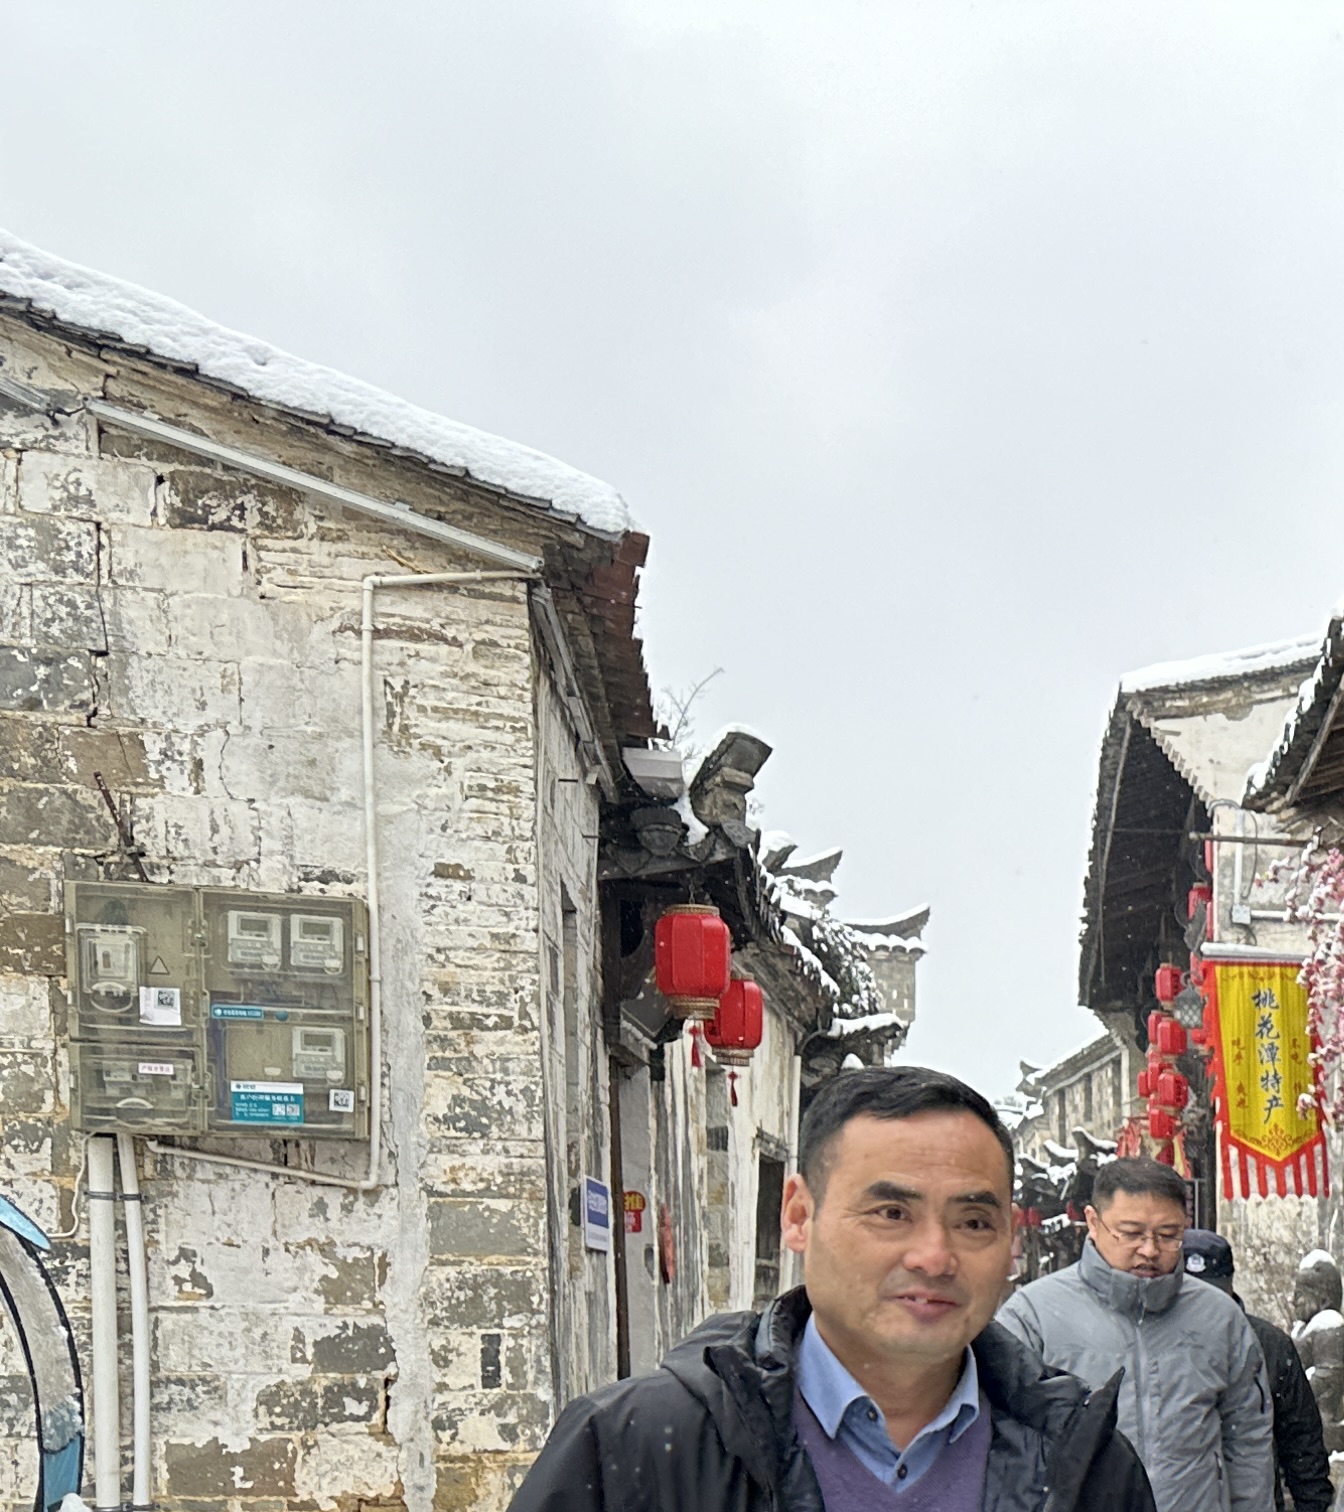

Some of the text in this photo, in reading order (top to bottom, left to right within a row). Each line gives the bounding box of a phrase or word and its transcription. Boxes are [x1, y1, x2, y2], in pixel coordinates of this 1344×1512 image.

[1251, 988, 1285, 1124] 桃花潭特产
